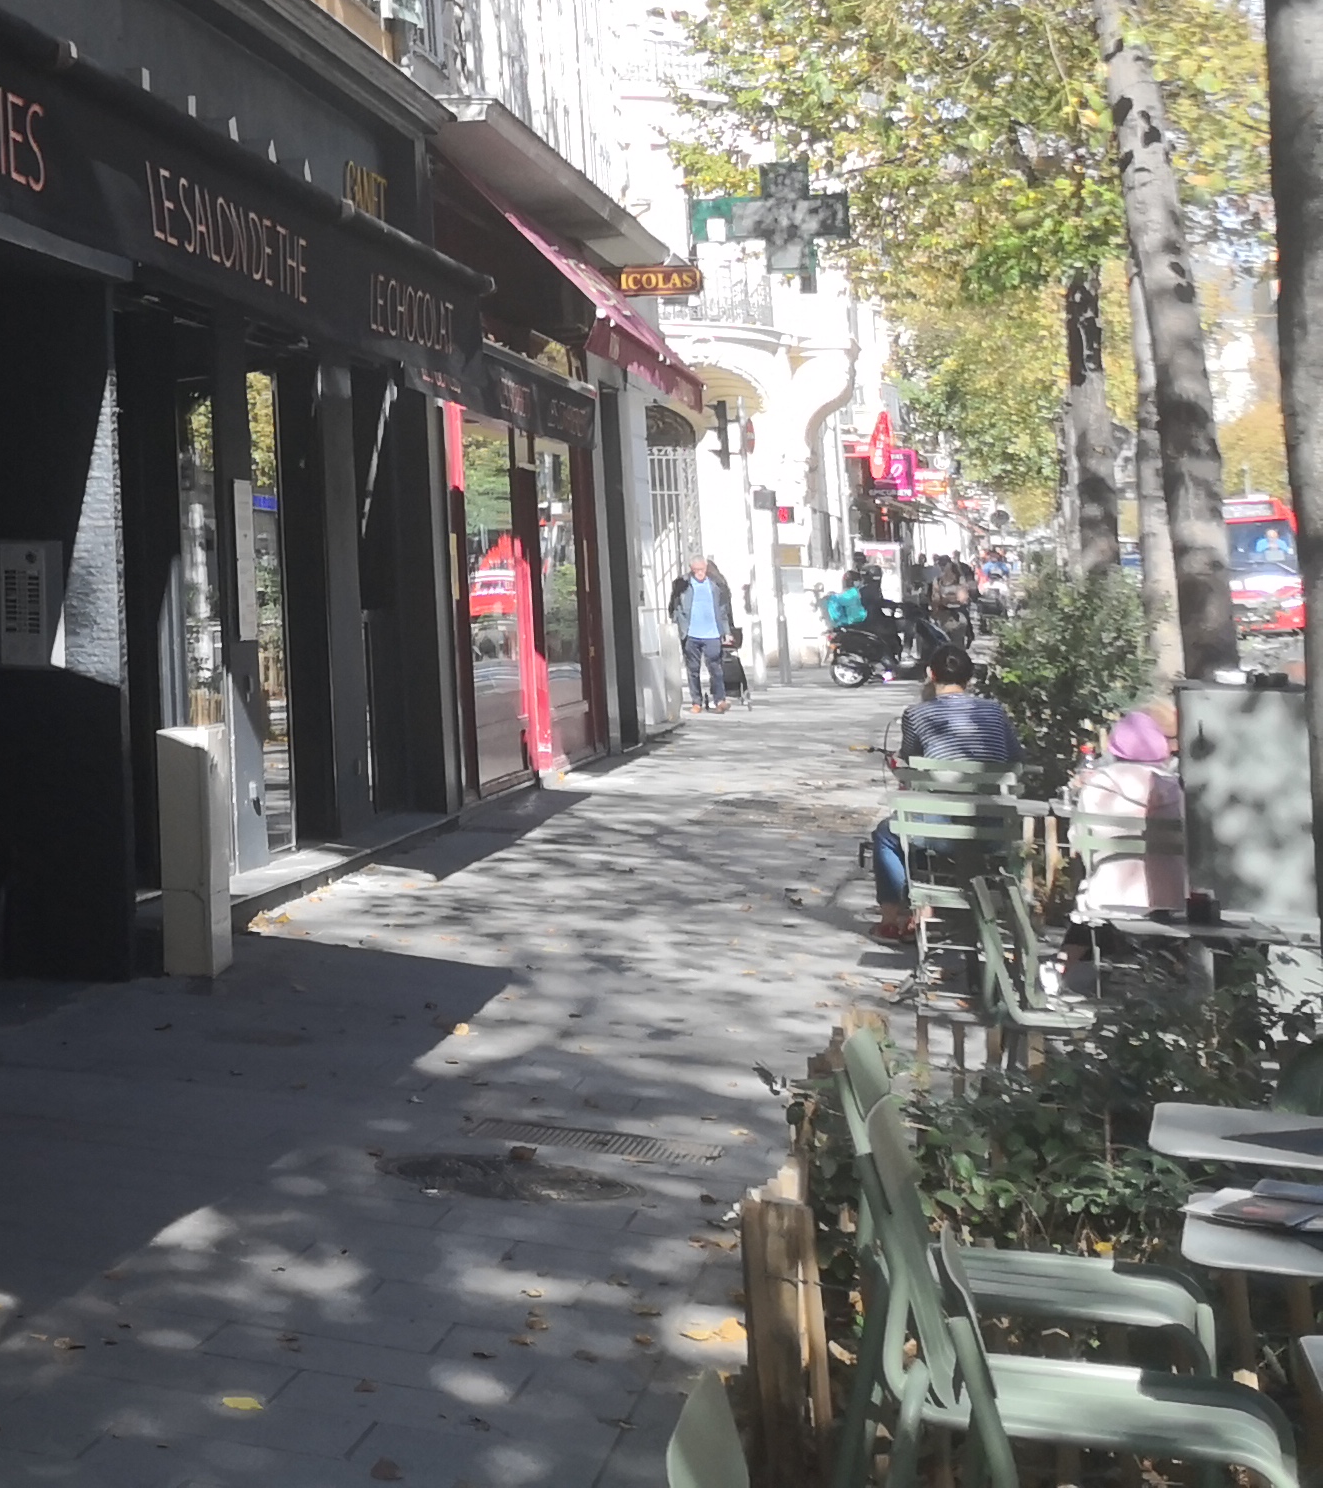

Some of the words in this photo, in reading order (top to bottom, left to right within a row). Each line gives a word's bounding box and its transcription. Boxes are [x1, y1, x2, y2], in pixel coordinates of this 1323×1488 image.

[145, 160, 178, 247] LE
[179, 177, 248, 275] SALON
[248, 211, 275, 287] DE
[275, 223, 308, 303] THE
[370, 272, 385, 332] LE
[387, 278, 454, 354] CHOCOLAT
[616, 272, 693, 290] ICOLAS
